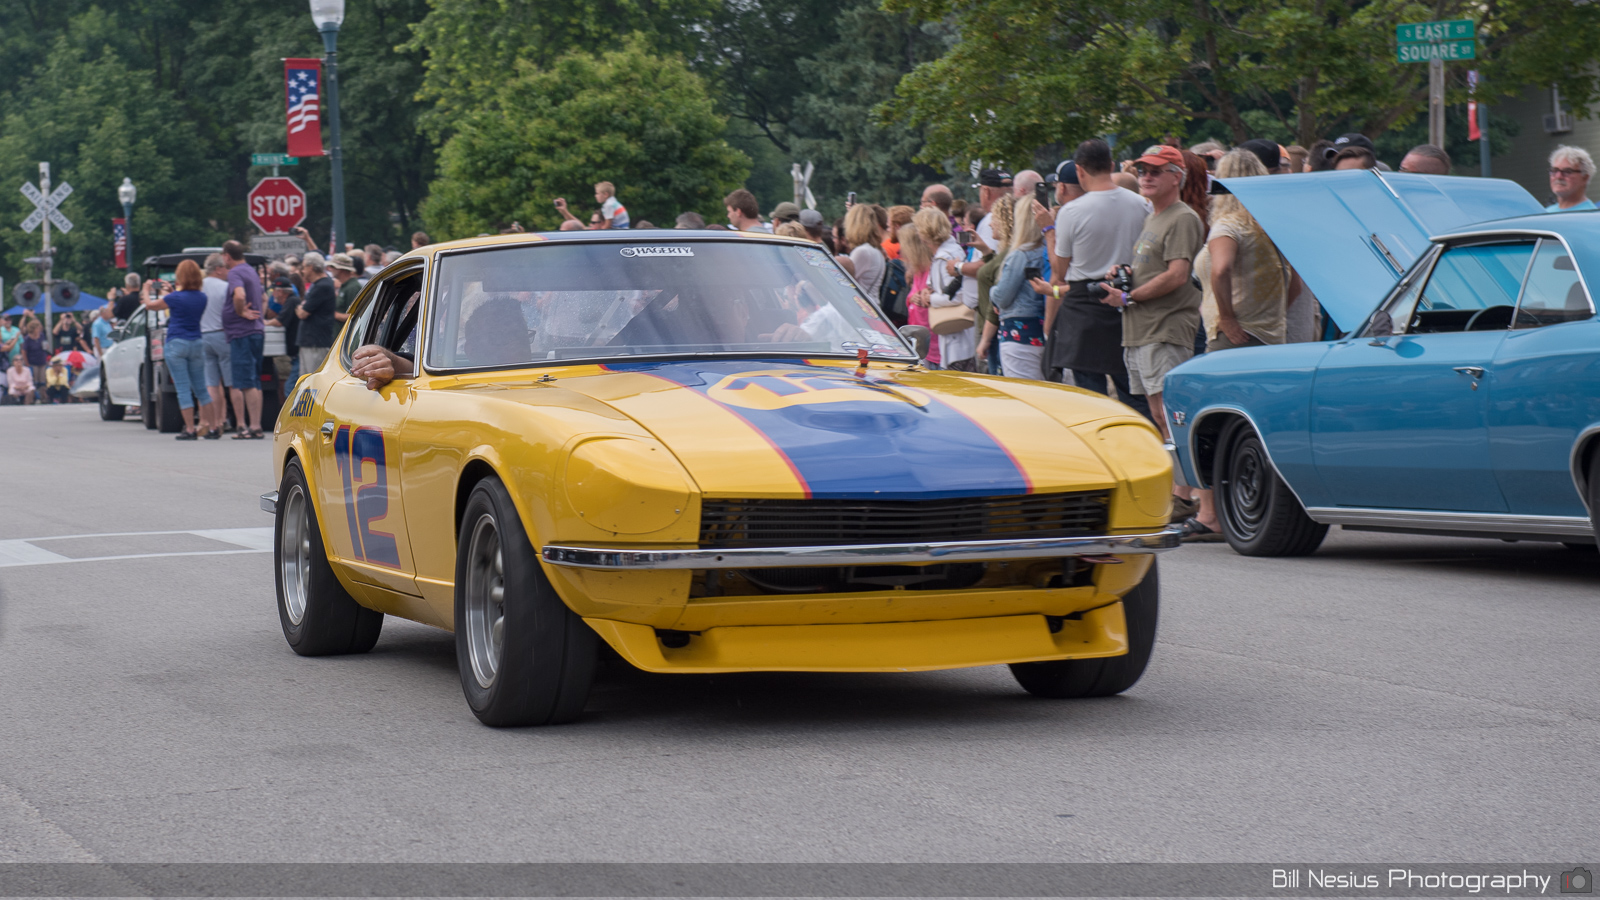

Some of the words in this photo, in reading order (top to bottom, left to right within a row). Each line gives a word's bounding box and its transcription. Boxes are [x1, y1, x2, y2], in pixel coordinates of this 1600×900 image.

[1405, 29, 1411, 38] S
[1415, 23, 1450, 39] EAST
[1400, 44, 1459, 60] SQUARE
[256, 155, 285, 165] RHINE
[23, 185, 44, 206] RAIL
[49, 209, 70, 231] ROAD
[252, 195, 302, 217] STOP
[253, 241, 277, 251] CROSS
[278, 240, 306, 250] TRAFFIC
[334, 424, 402, 570] 12
